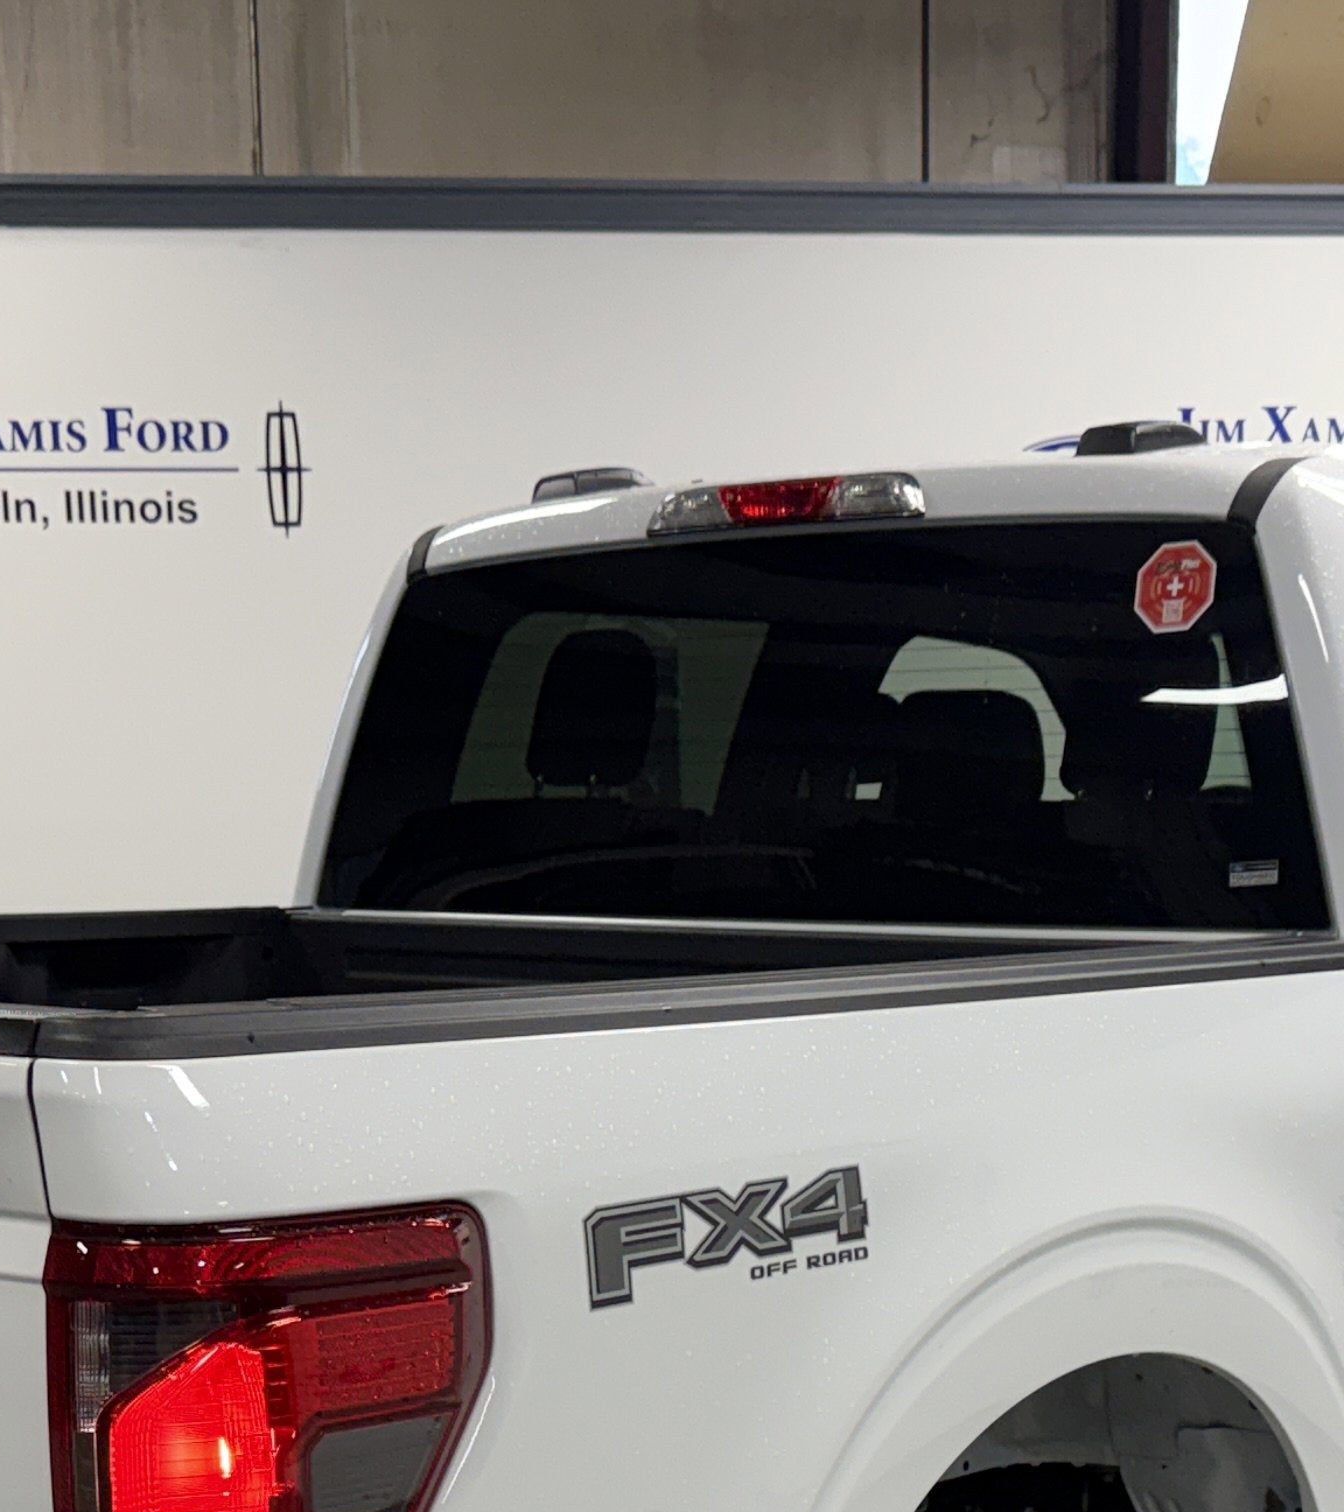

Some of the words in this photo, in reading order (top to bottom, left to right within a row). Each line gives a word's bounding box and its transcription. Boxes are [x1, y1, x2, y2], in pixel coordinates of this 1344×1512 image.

[64, 489, 199, 525] Illinois
[583, 1164, 869, 1313] FX4
[749, 1258, 798, 1281] OFF
[806, 1245, 869, 1270] ROAD
